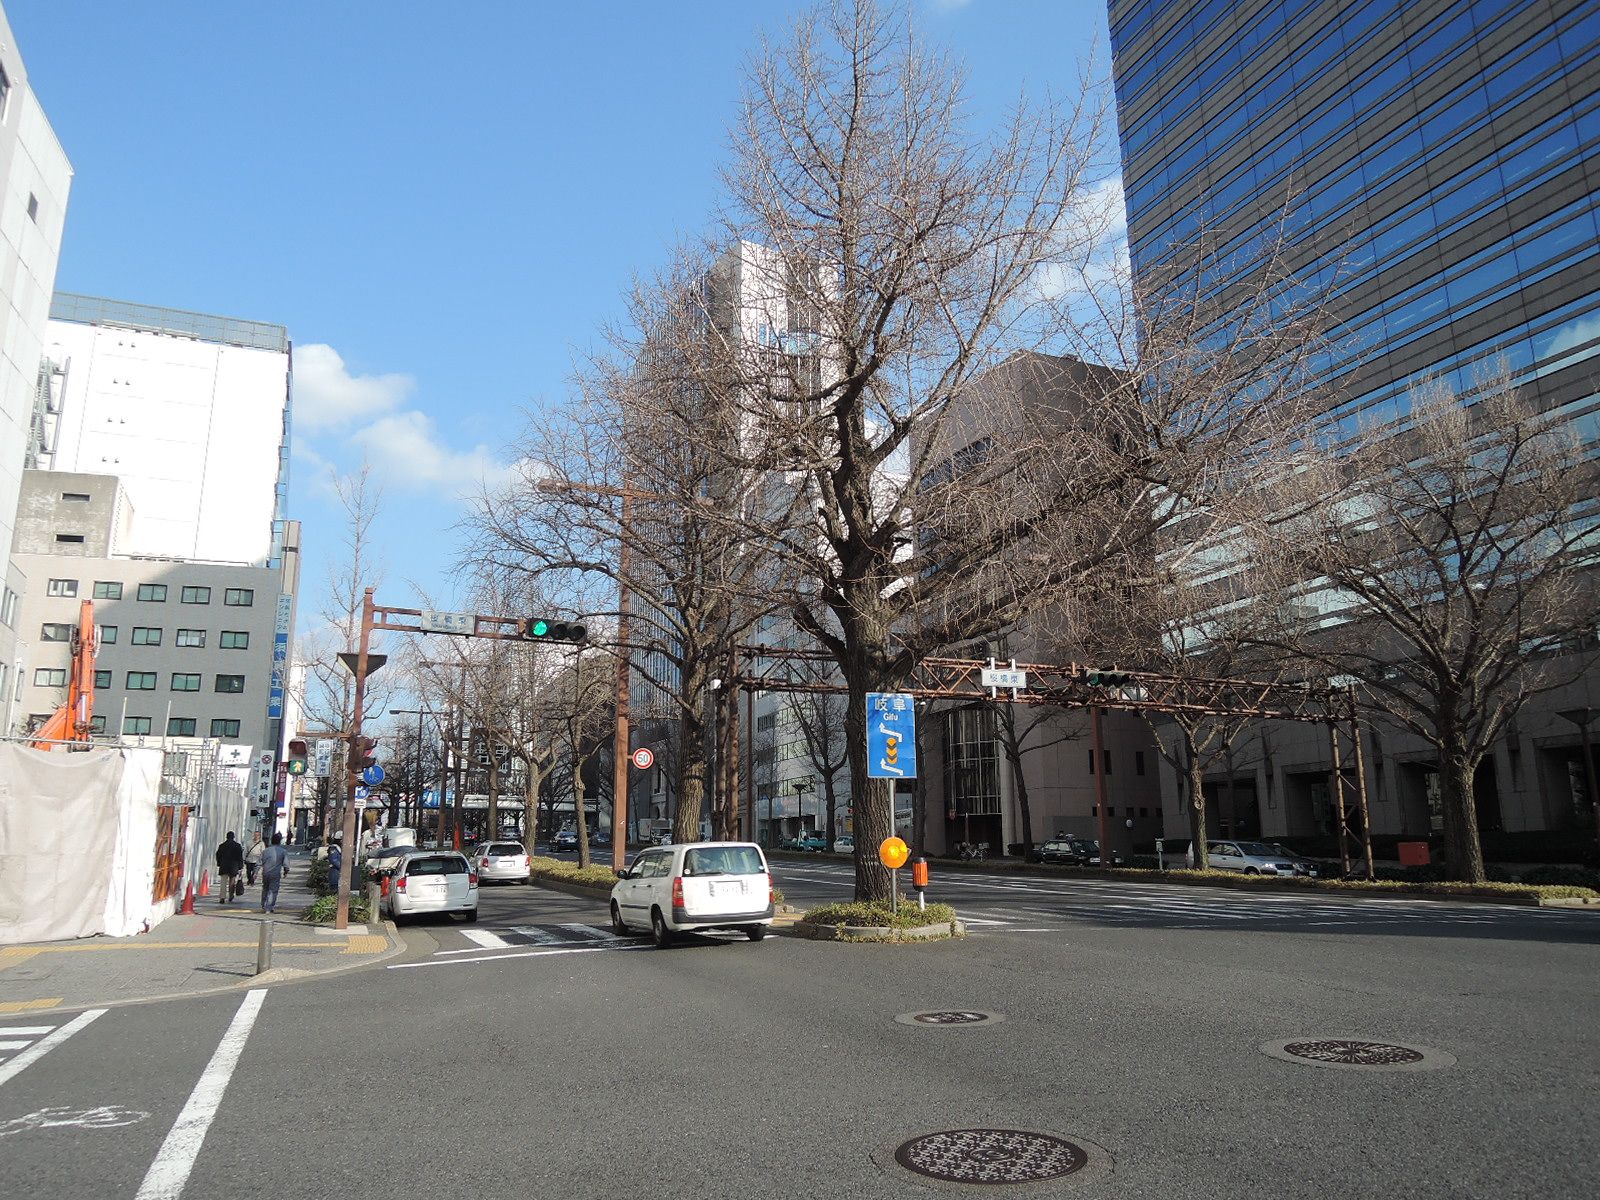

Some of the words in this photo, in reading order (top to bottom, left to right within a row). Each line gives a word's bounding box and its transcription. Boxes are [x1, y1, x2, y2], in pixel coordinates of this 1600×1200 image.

[874, 697, 906, 712] 岐阜
[883, 712, 899, 721] Gifu
[637, 753, 649, 763] 50
